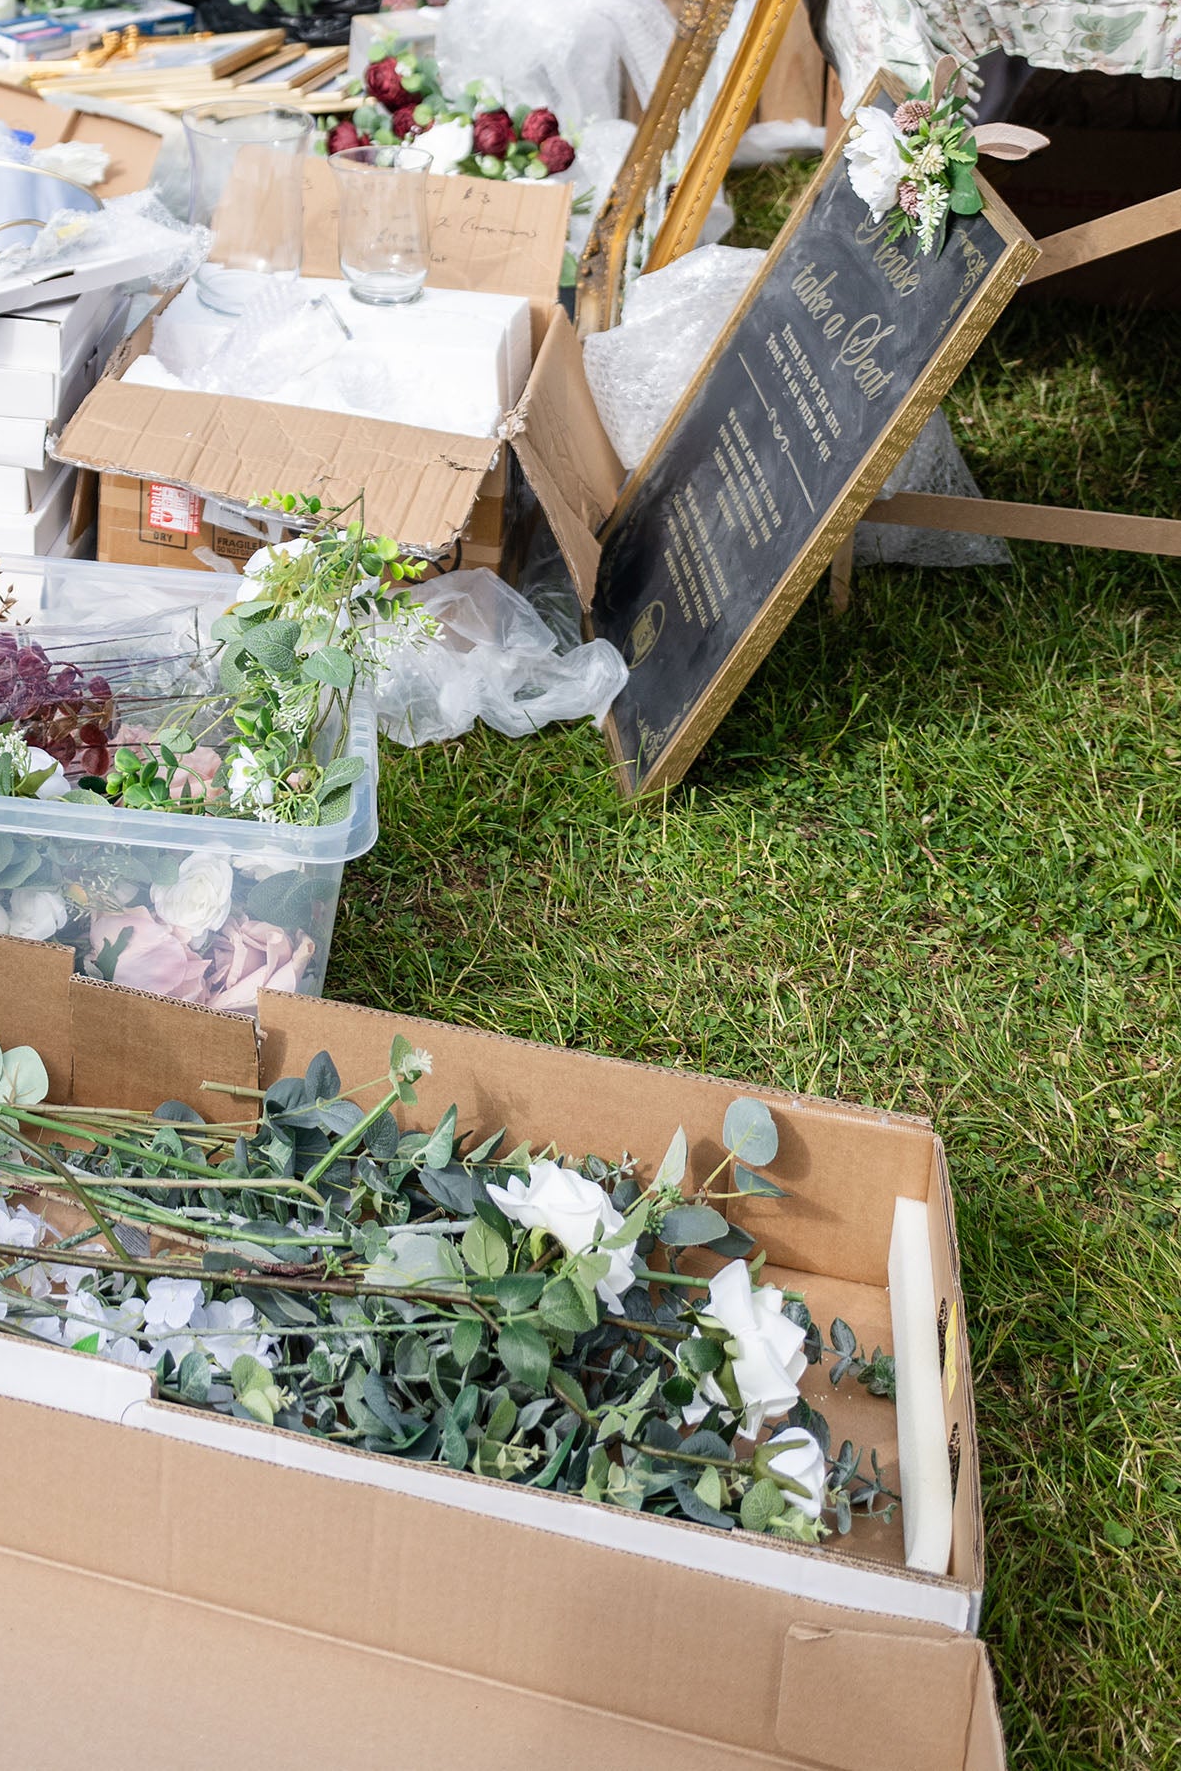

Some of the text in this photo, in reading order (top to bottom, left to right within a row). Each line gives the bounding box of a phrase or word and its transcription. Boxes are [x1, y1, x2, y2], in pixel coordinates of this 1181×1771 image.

[791, 262, 896, 401] take a Seat
[788, 377, 801, 397] ARE
[797, 395, 815, 430] UNITED
[812, 428, 821, 442] AS
[818, 441, 829, 461] ONE
[151, 484, 163, 526] FRAGILE
[154, 532, 173, 542] DRY
[217, 537, 257, 551] FRAGILE
